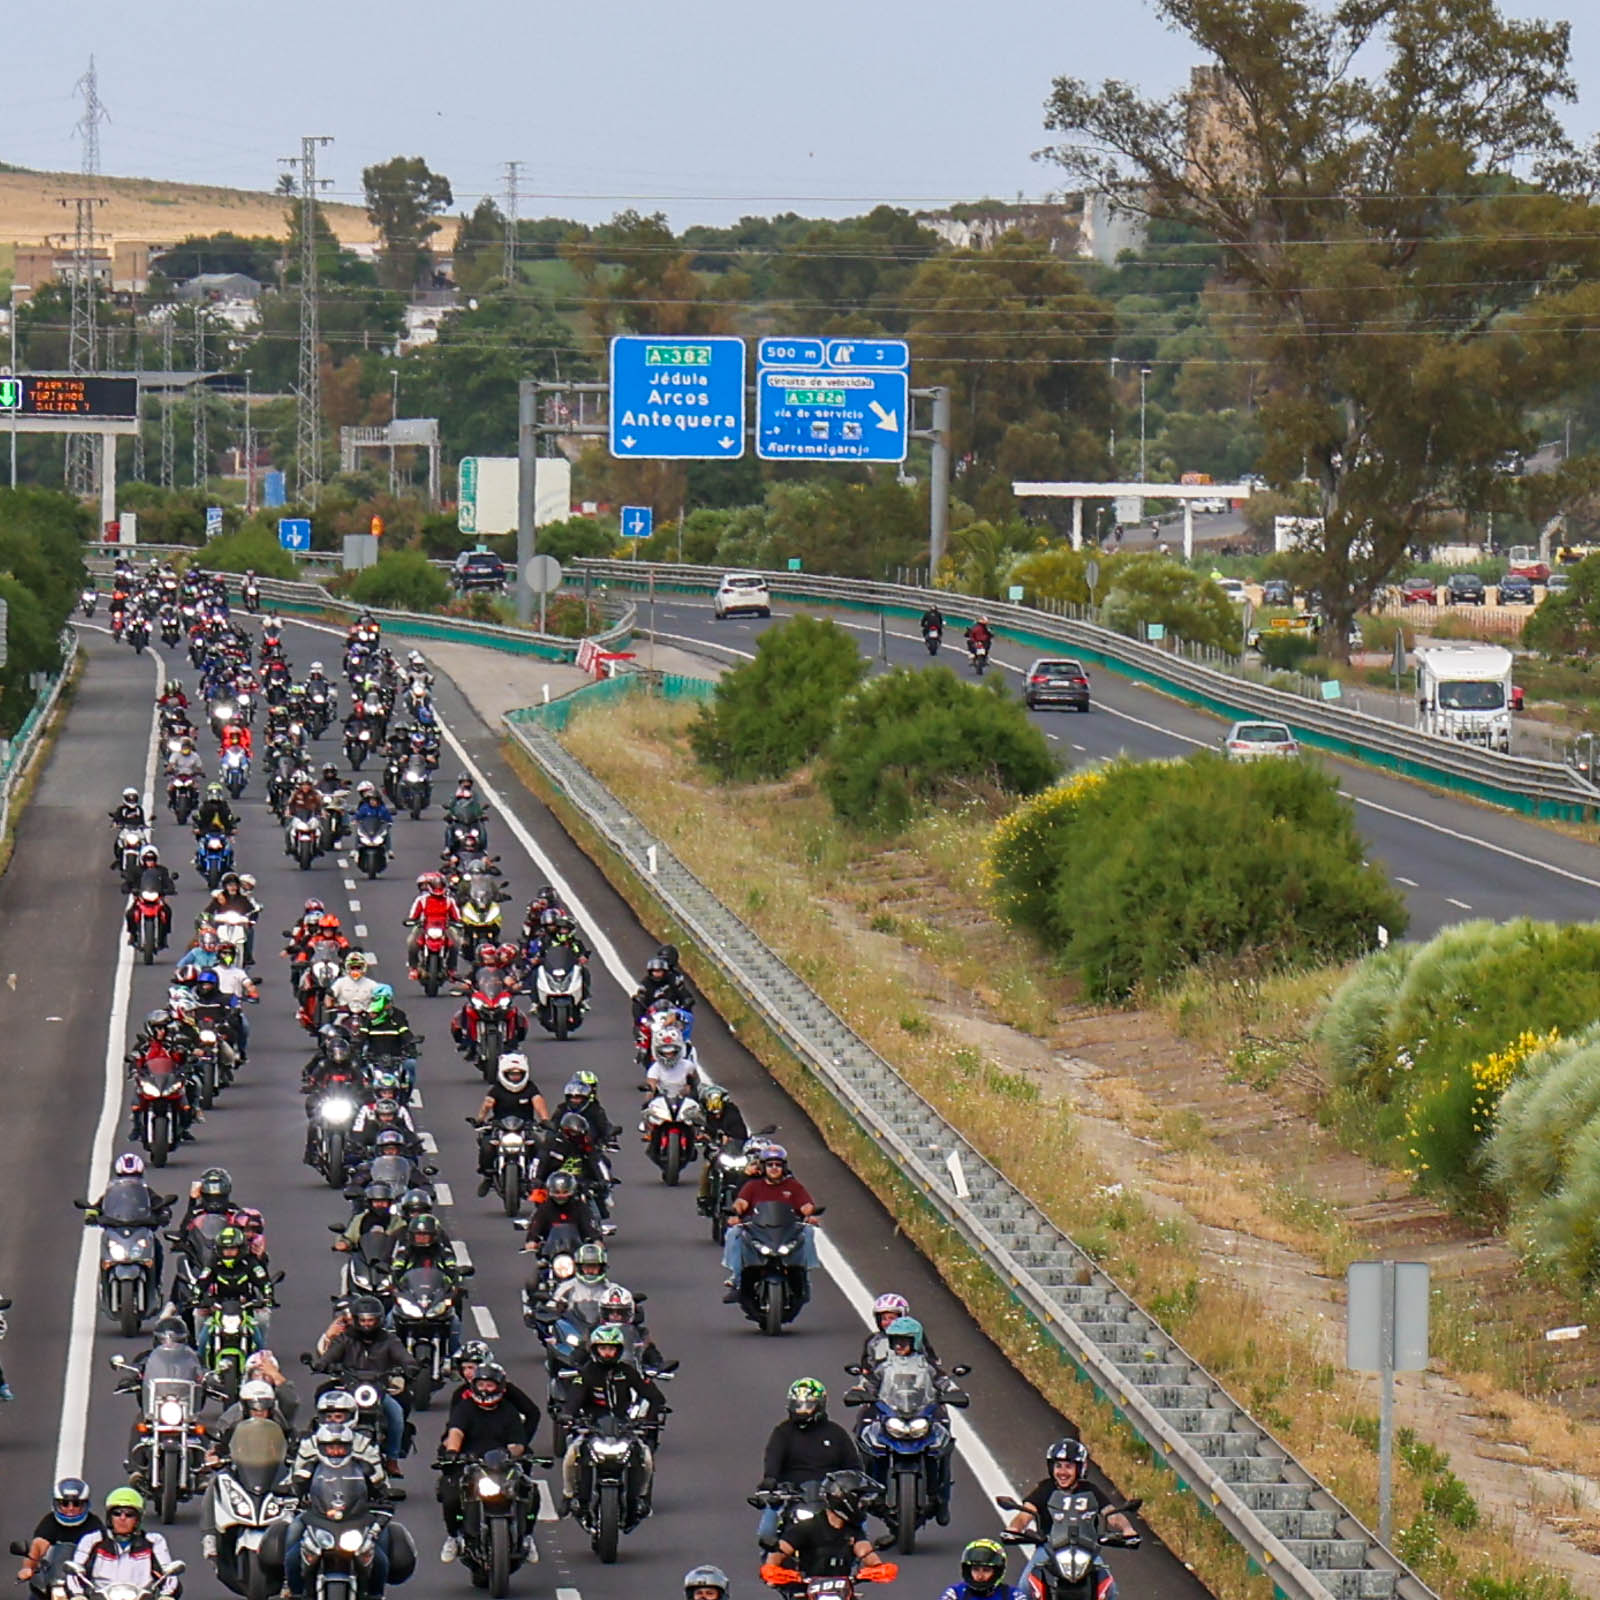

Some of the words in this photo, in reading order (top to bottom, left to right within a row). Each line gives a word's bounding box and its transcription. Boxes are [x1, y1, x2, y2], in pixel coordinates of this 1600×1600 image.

[650, 349, 708, 364] A-382
[767, 346, 796, 358] 500
[804, 349, 817, 359] m
[649, 371, 708, 386] Jédula
[647, 389, 709, 406] Arcos
[621, 410, 736, 431] Antequera
